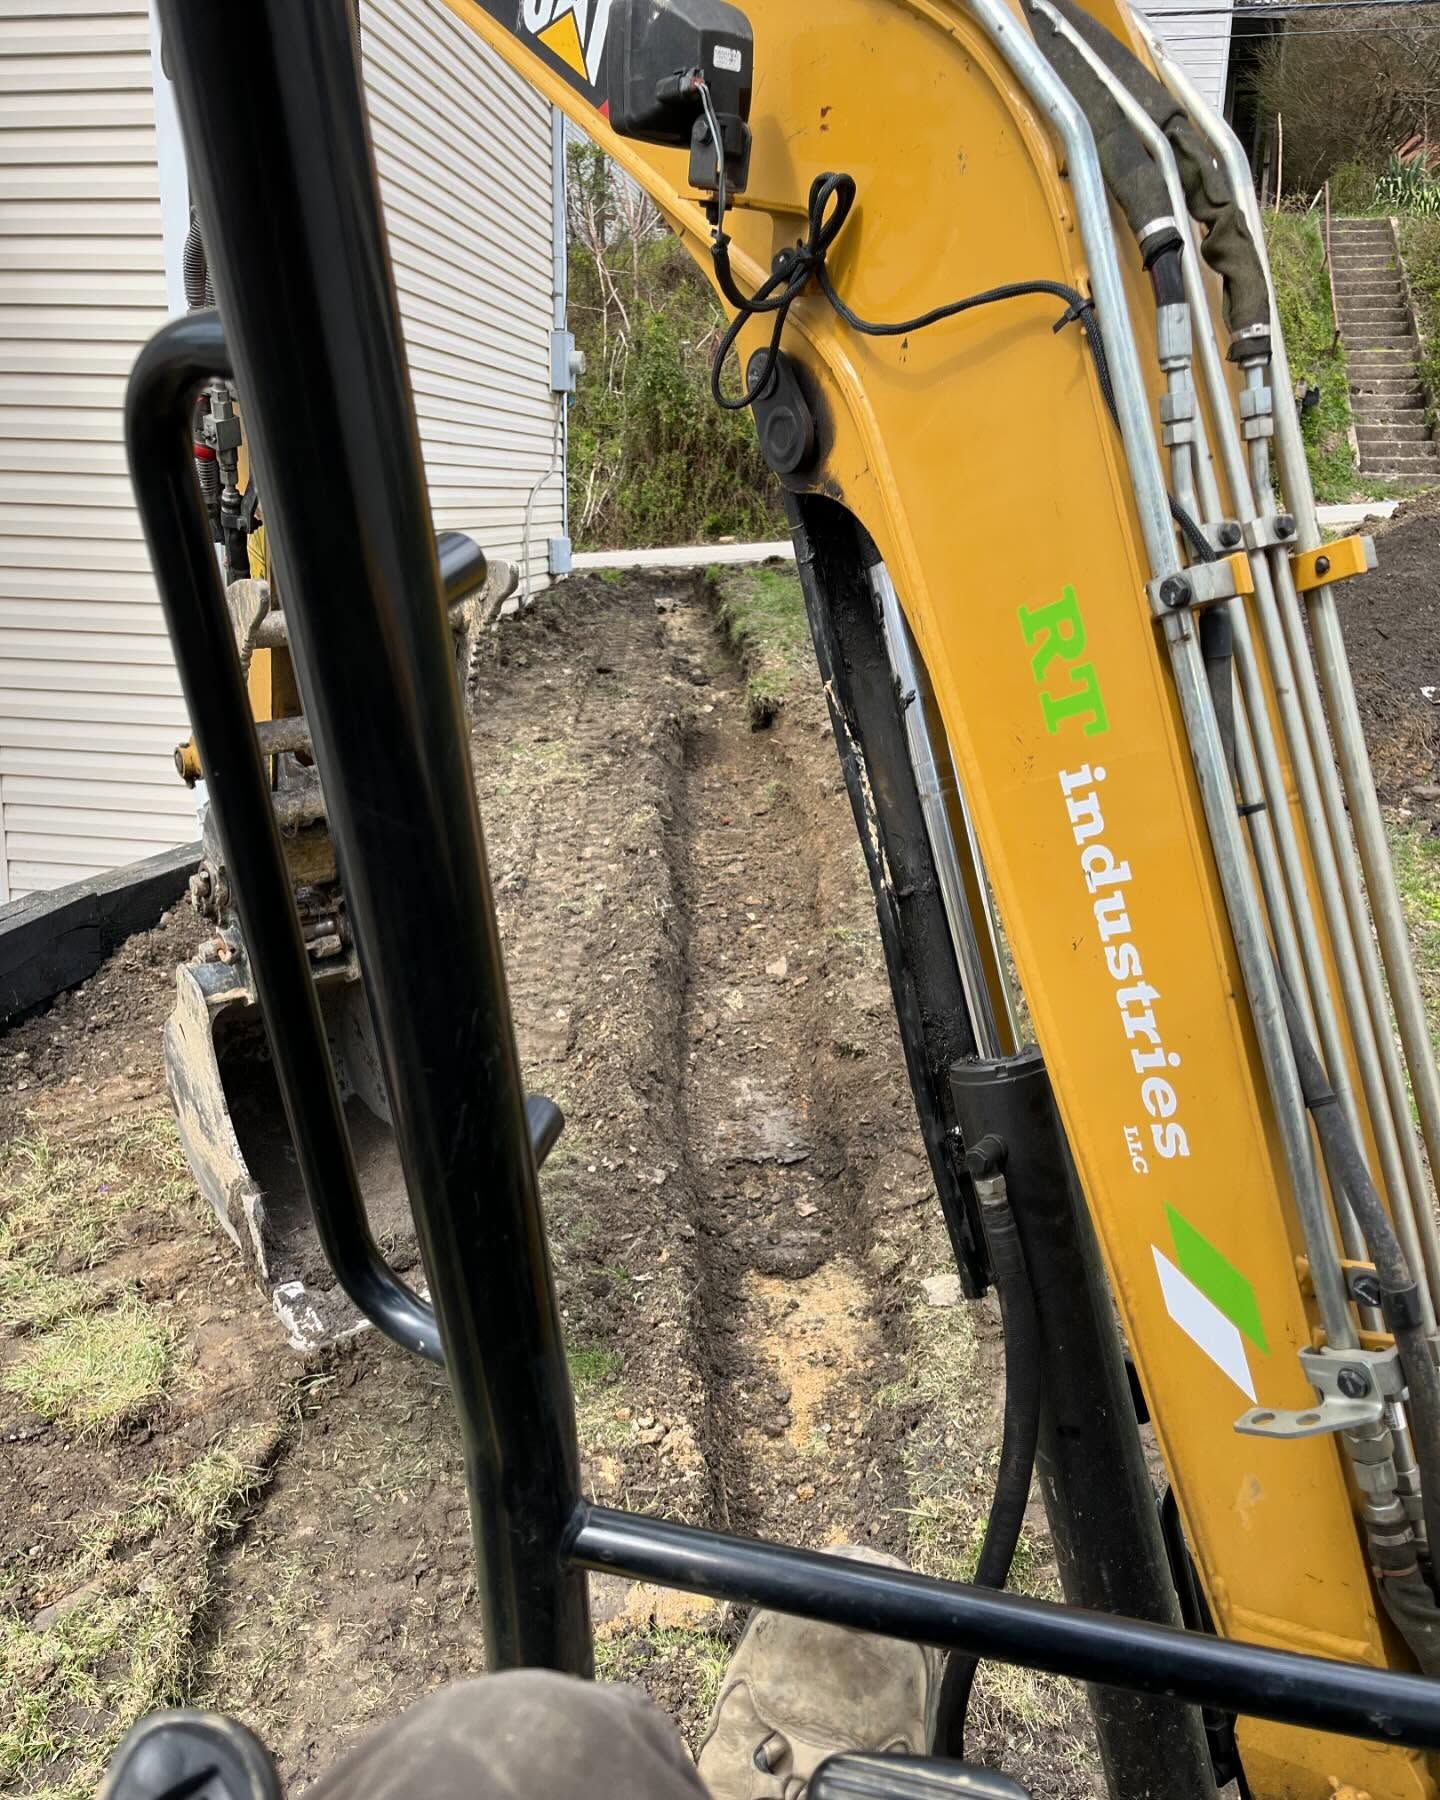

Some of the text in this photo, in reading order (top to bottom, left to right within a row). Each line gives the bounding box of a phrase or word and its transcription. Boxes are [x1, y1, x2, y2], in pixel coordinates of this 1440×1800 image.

[1016, 584, 1190, 1159] RT industries
[1123, 1125, 1149, 1175] LLC
